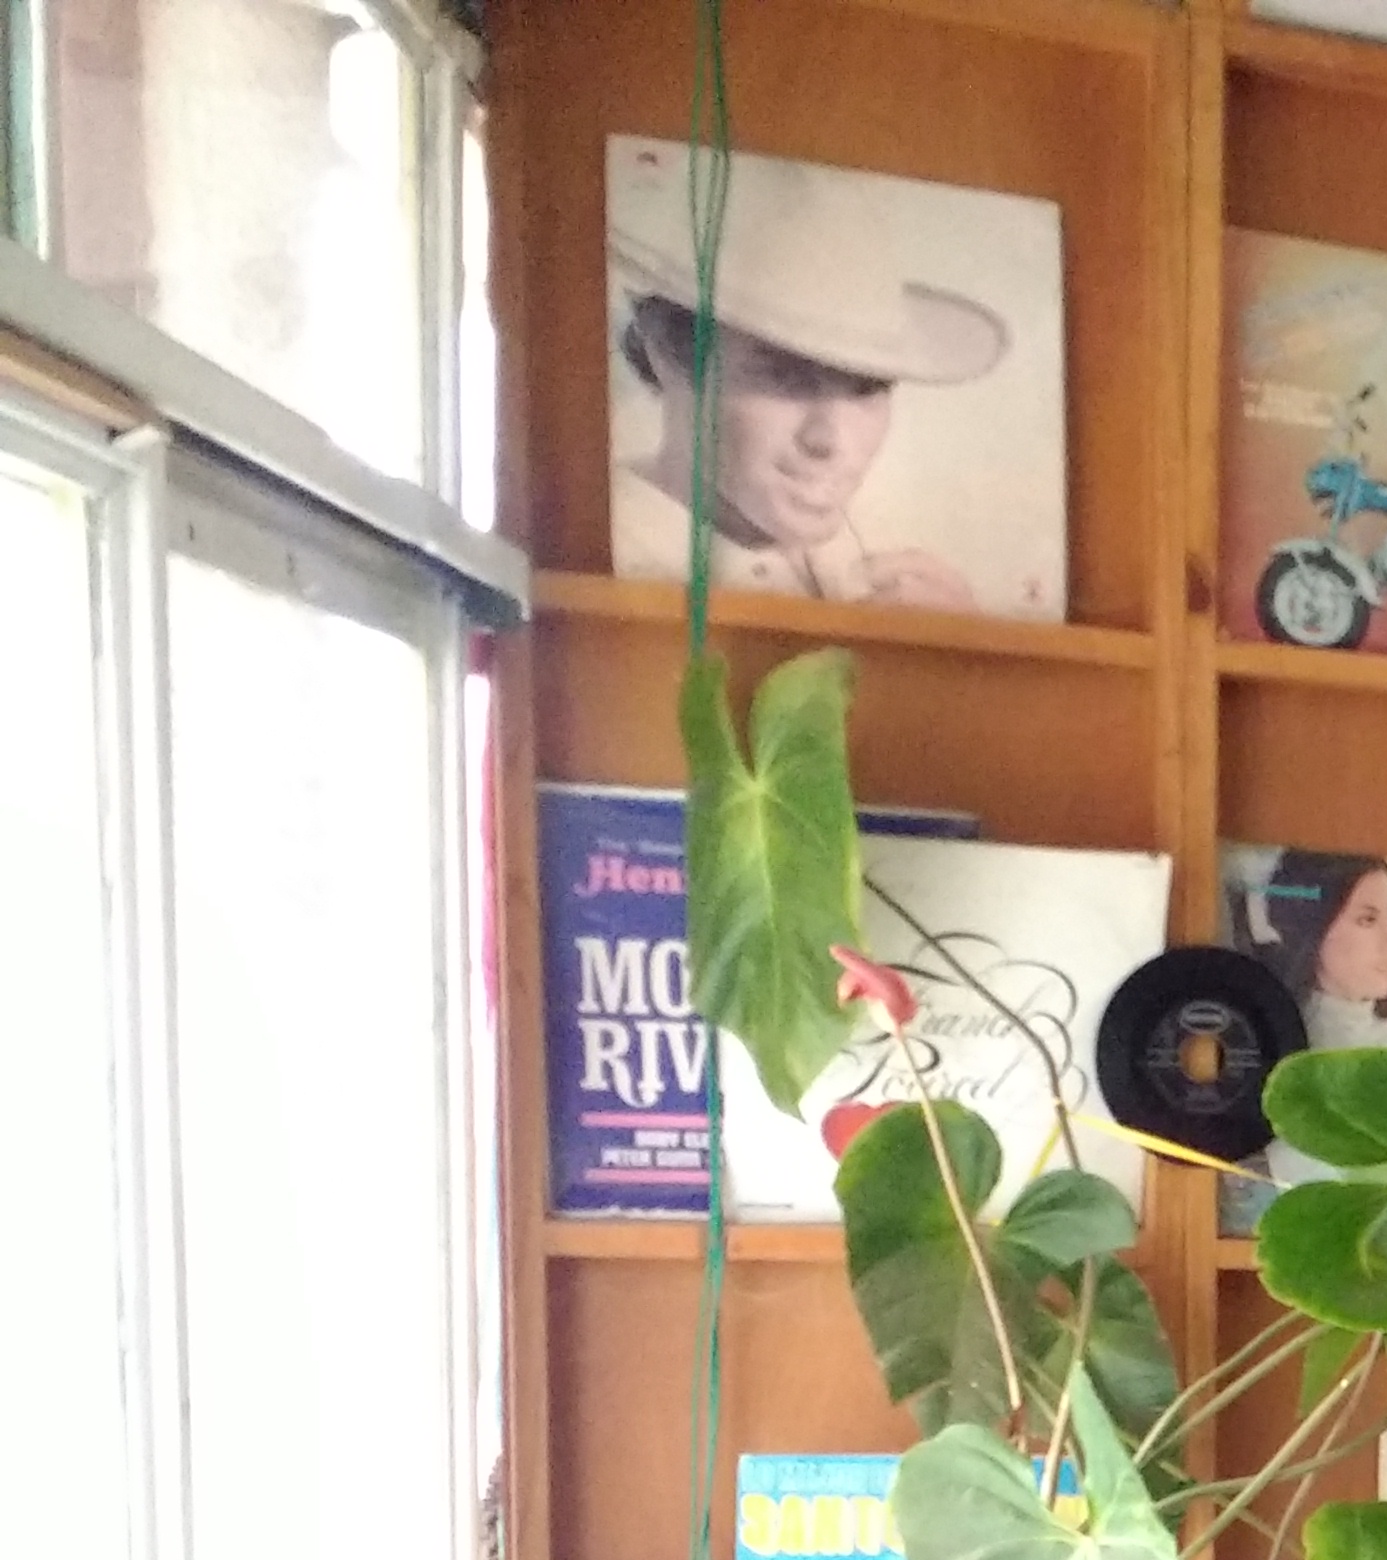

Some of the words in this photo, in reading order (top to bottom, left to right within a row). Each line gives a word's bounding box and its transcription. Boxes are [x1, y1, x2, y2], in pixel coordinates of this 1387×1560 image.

[573, 853, 686, 898] Hen
[574, 936, 692, 1016] MO
[580, 1020, 711, 1108] RIV
